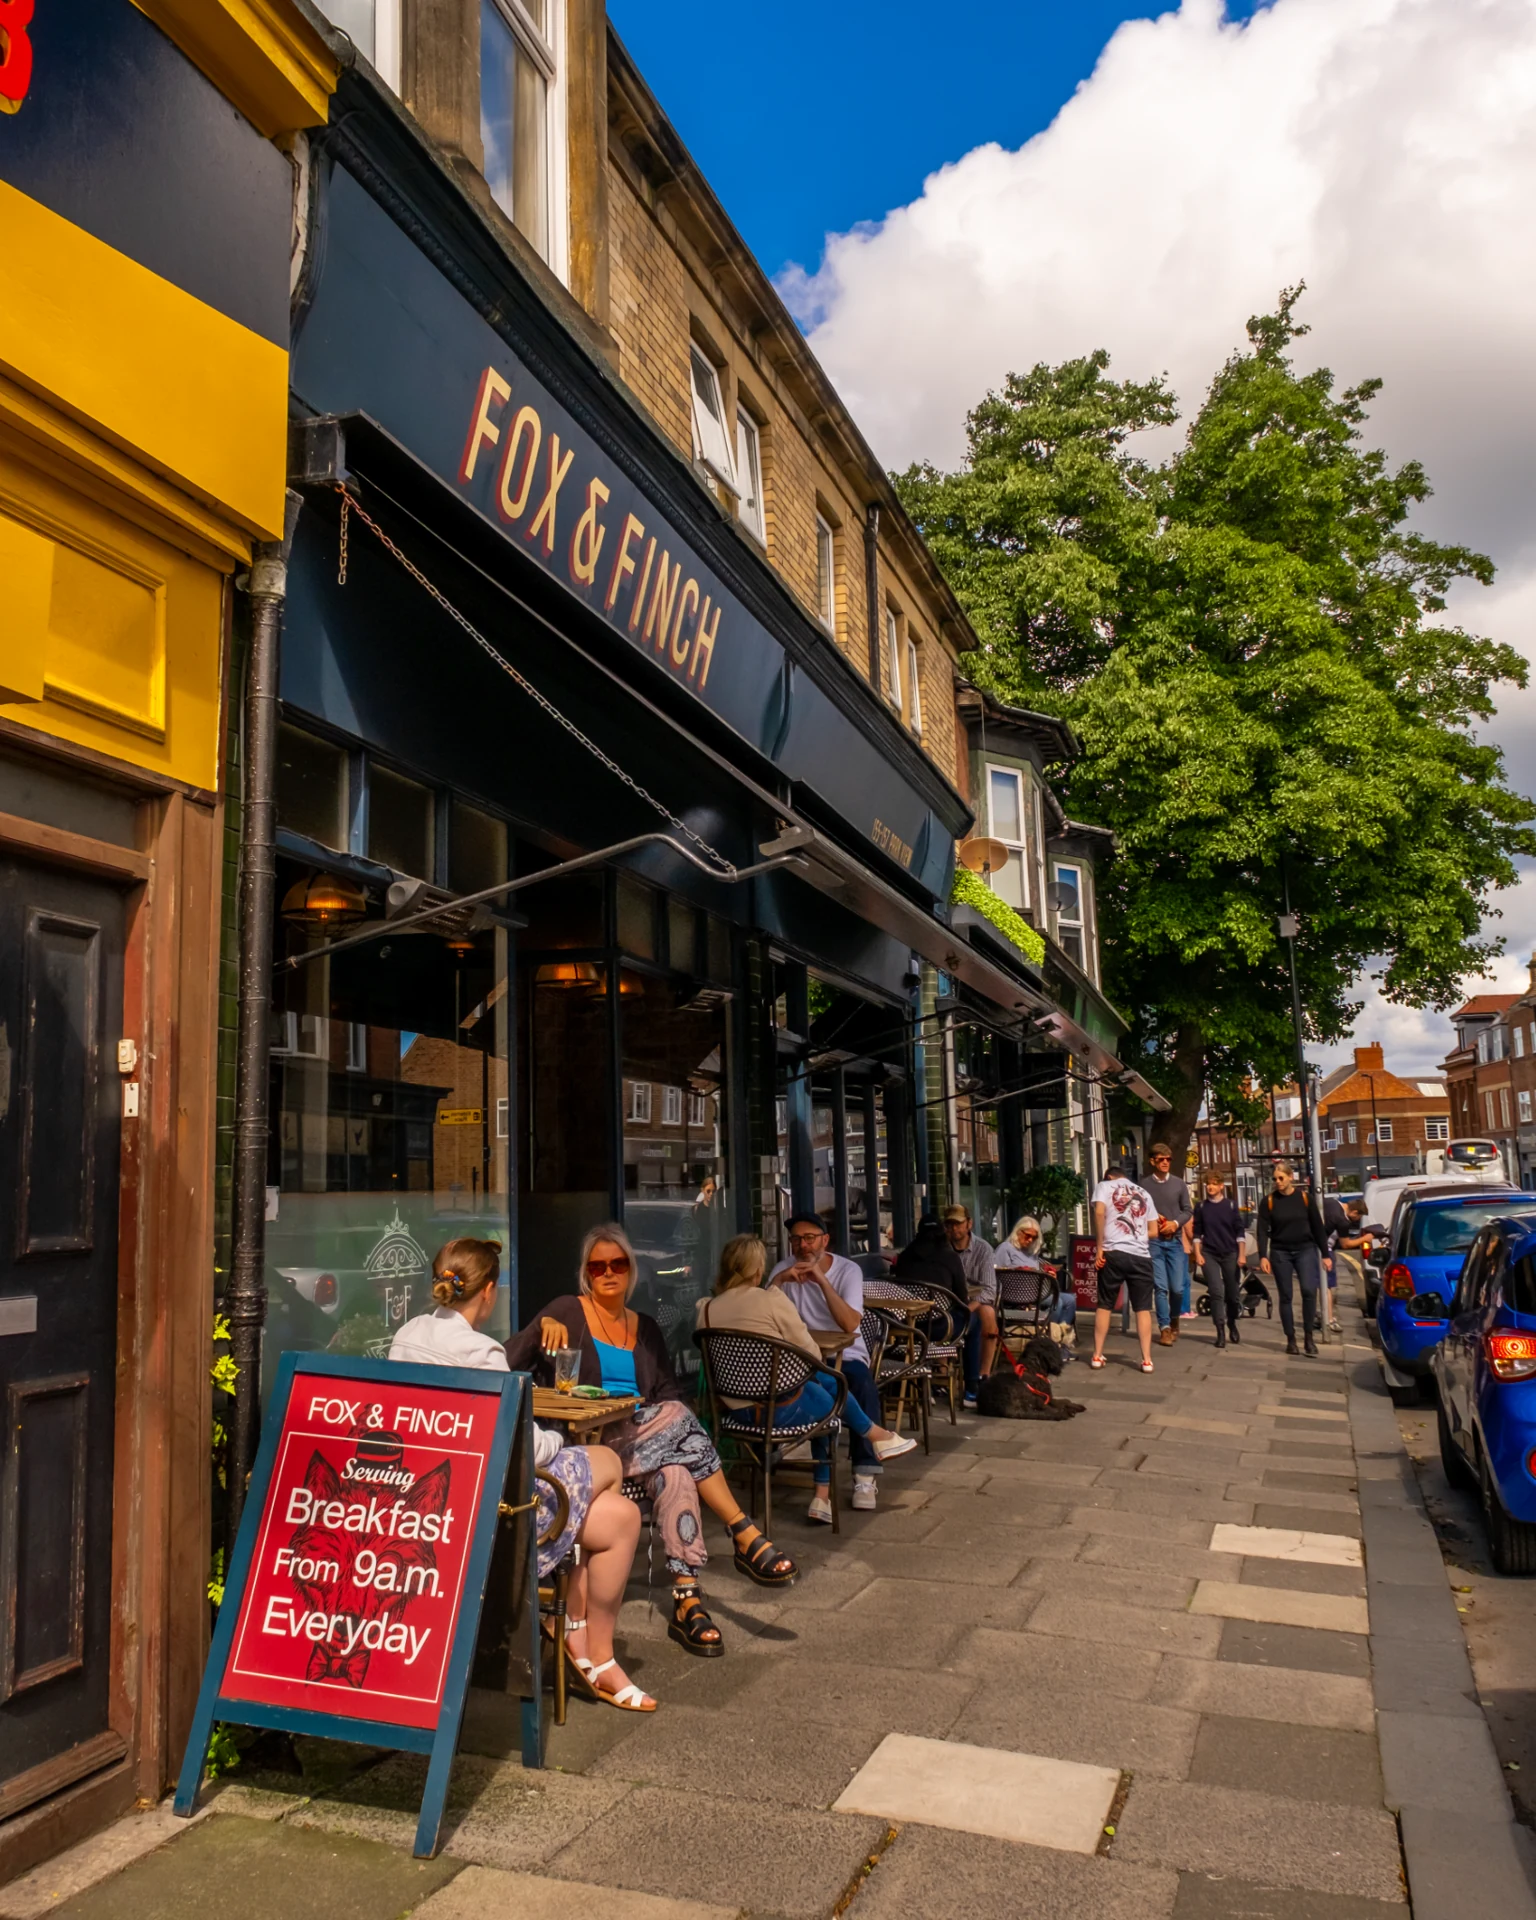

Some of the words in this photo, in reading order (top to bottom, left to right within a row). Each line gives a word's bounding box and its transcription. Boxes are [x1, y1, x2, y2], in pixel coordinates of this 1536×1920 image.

[458, 366, 575, 557] FOX
[569, 476, 610, 587] &
[604, 512, 722, 692] FINCH
[307, 1396, 361, 1426] FOX
[366, 1403, 384, 1429] &
[393, 1406, 474, 1439] FINCH
[340, 1457, 416, 1493] Serving
[285, 1487, 455, 1544] Breakfast
[272, 1548, 340, 1584] From
[352, 1550, 445, 1599] 9a.m.
[261, 1595, 432, 1665] Everyday
